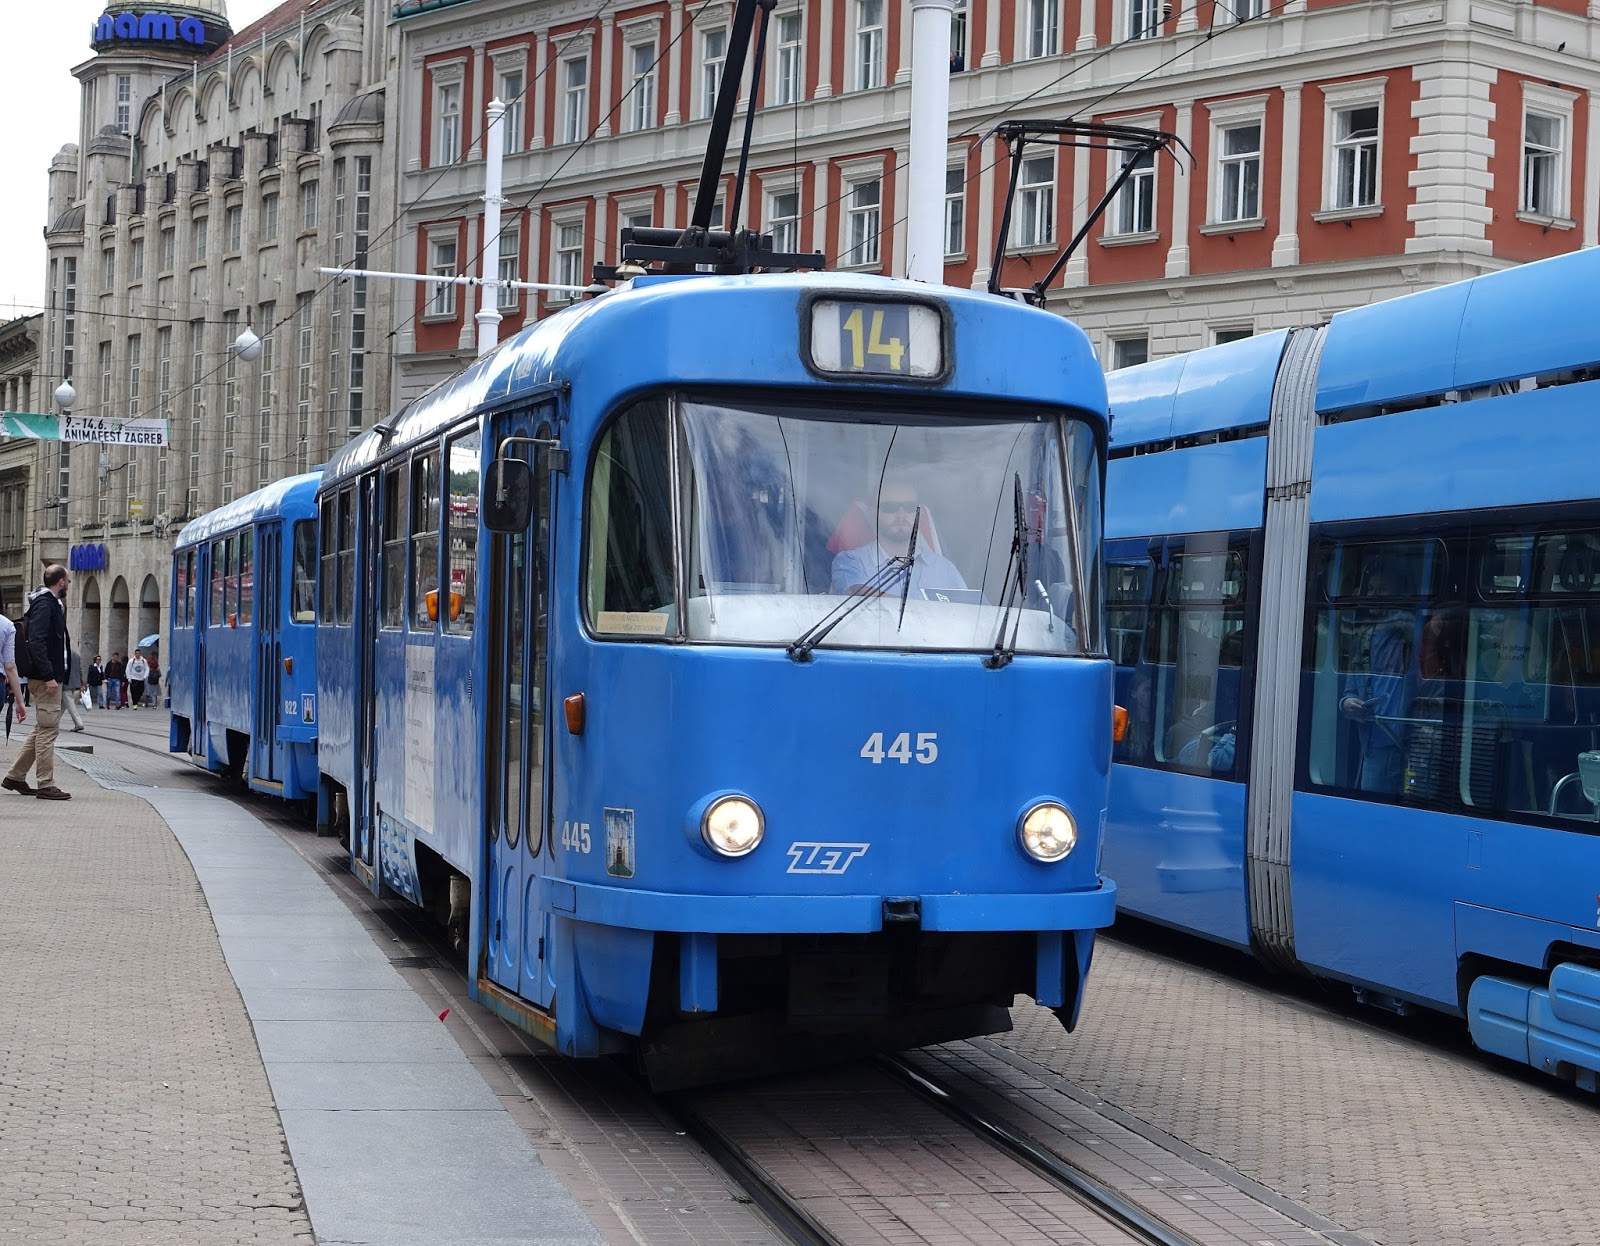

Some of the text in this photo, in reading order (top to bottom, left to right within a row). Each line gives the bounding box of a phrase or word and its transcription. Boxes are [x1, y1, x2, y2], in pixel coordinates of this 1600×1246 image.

[97, 12, 205, 45] nama
[843, 309, 904, 370] 14
[64, 429, 163, 445] ANIMAFEST ZAGREB
[284, 700, 298, 715] 822
[859, 732, 938, 765] 445
[561, 820, 592, 854] 445
[786, 841, 871, 875] ZET
